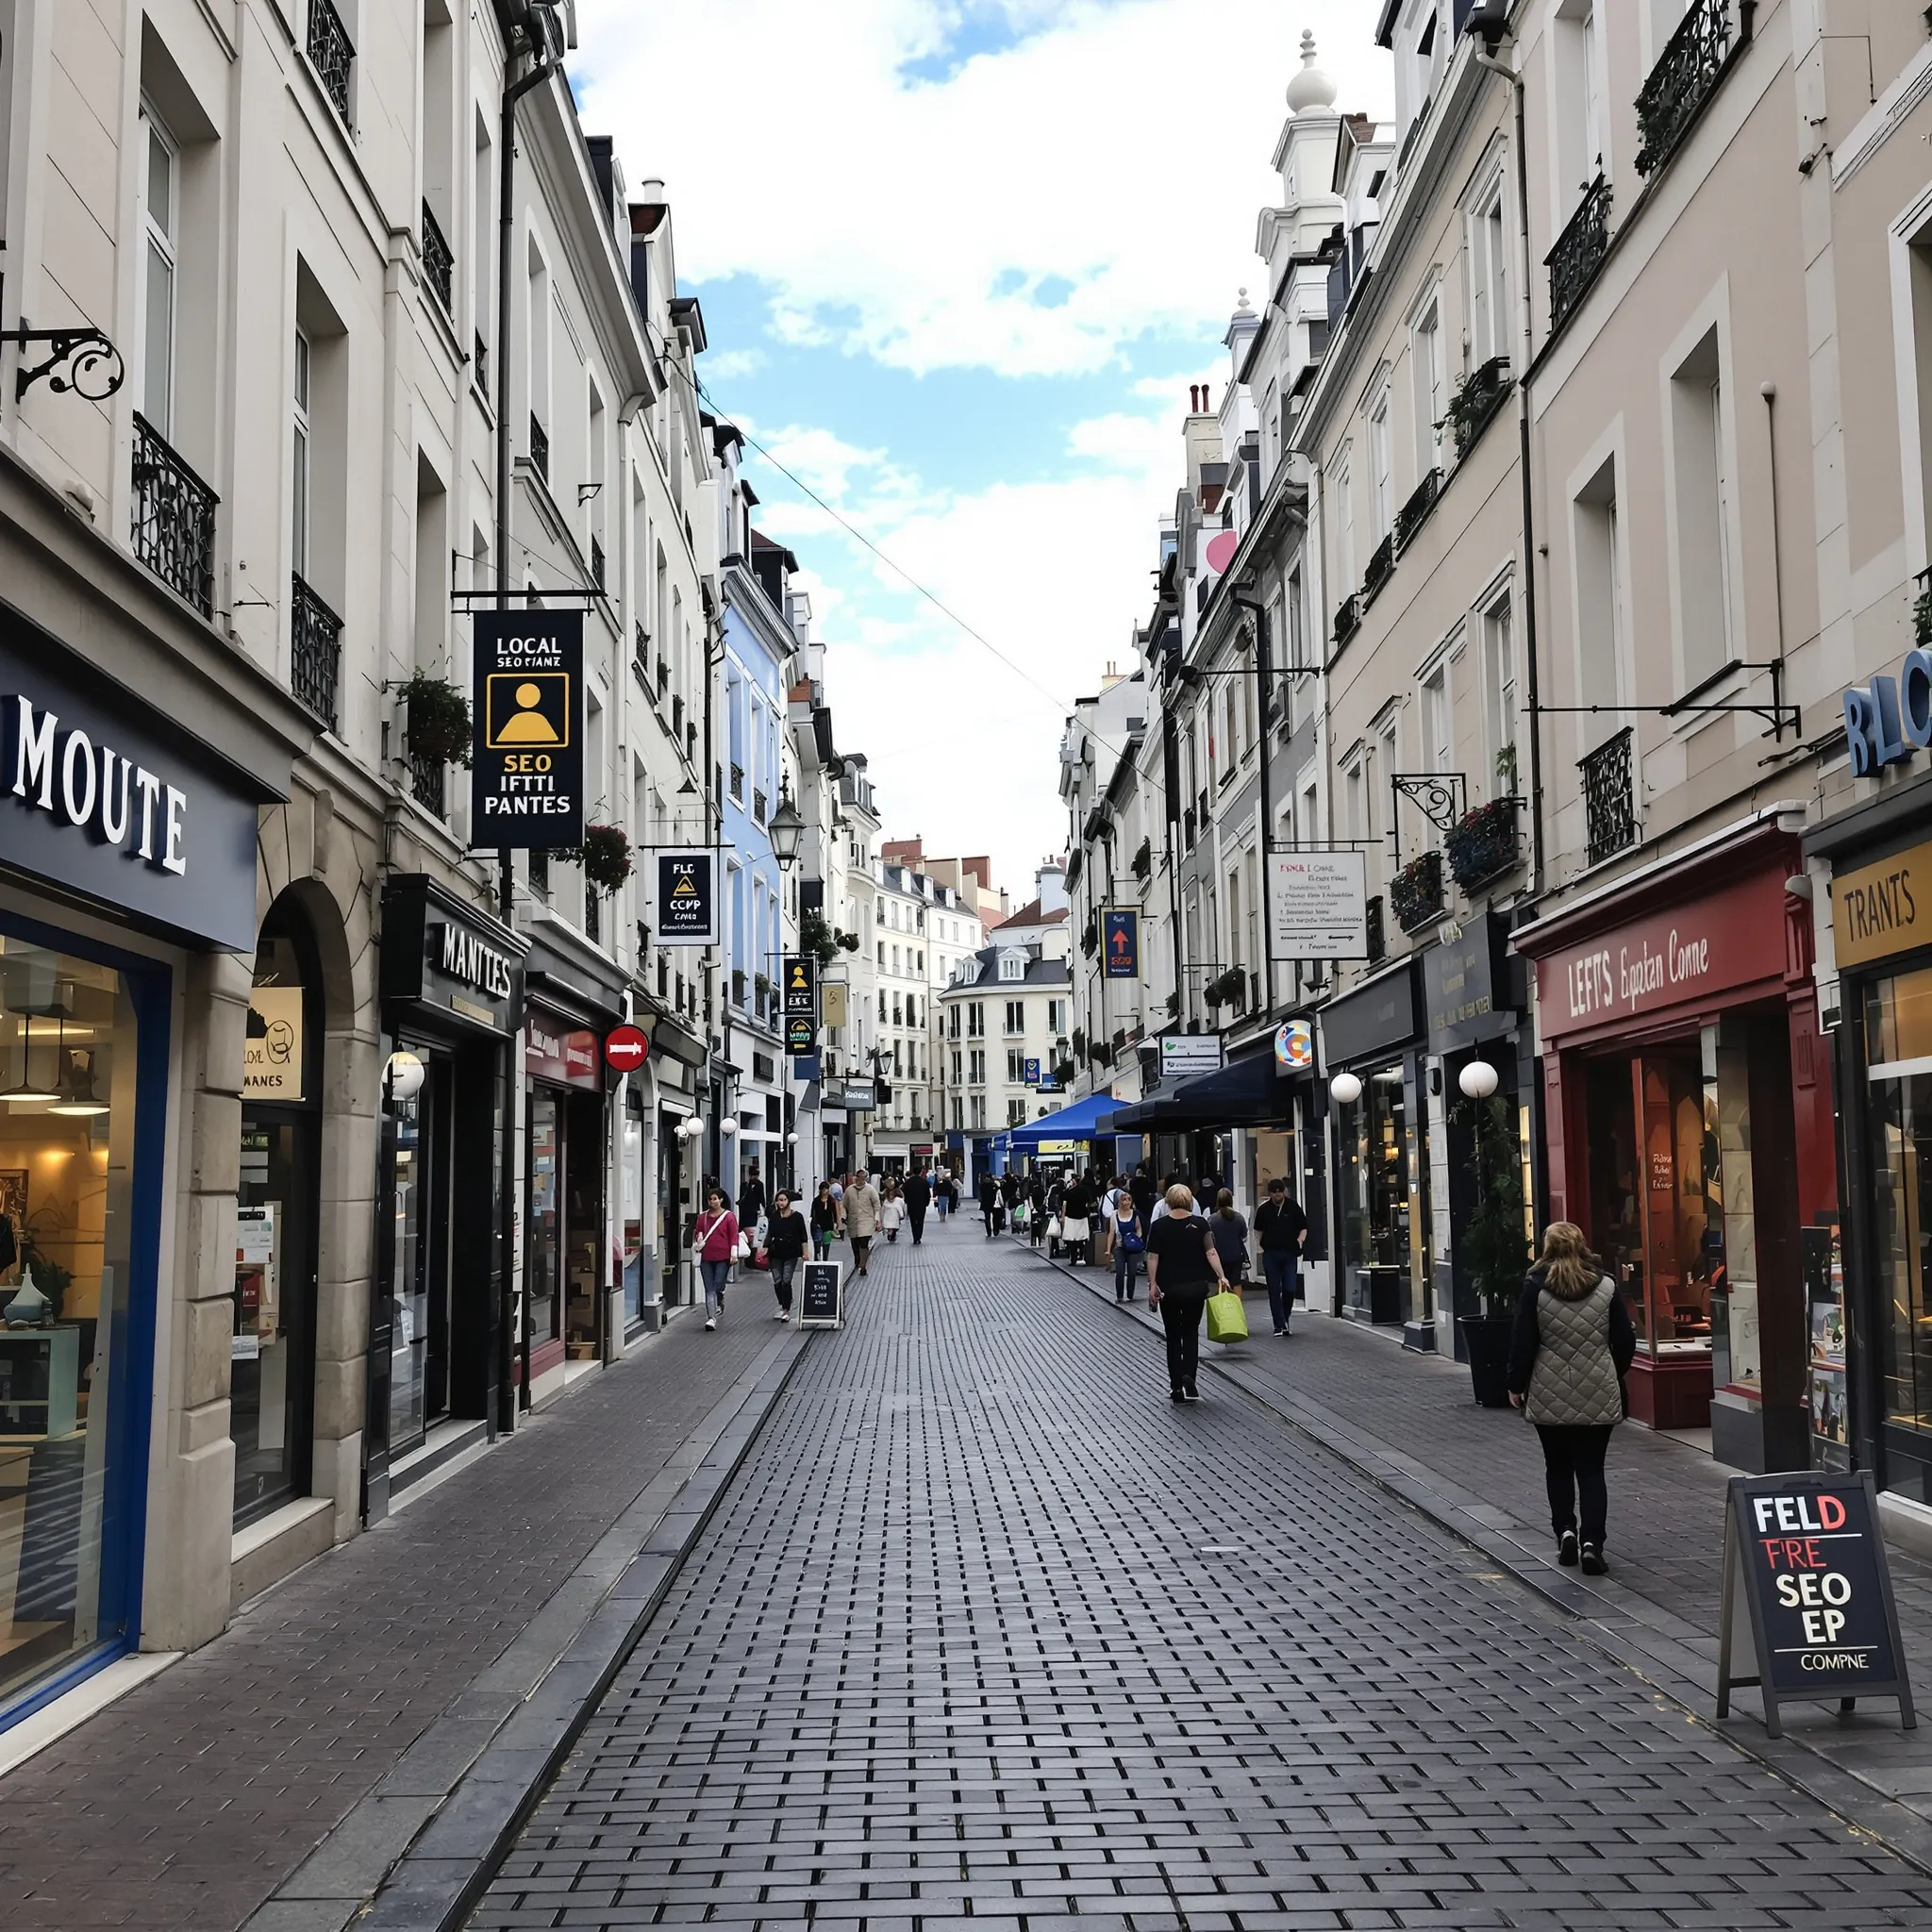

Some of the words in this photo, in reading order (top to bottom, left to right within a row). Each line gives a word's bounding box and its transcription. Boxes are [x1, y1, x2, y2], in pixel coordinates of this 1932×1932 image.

[497, 637, 562, 655] LOCAL
[504, 754, 552, 773] SEO
[12, 694, 187, 876] MOUTE
[485, 795, 571, 814] PANTES
[1753, 1495, 1846, 1533] FELD
[1775, 1573, 1852, 1607] SEO
[1802, 1608, 1846, 1643] EP
